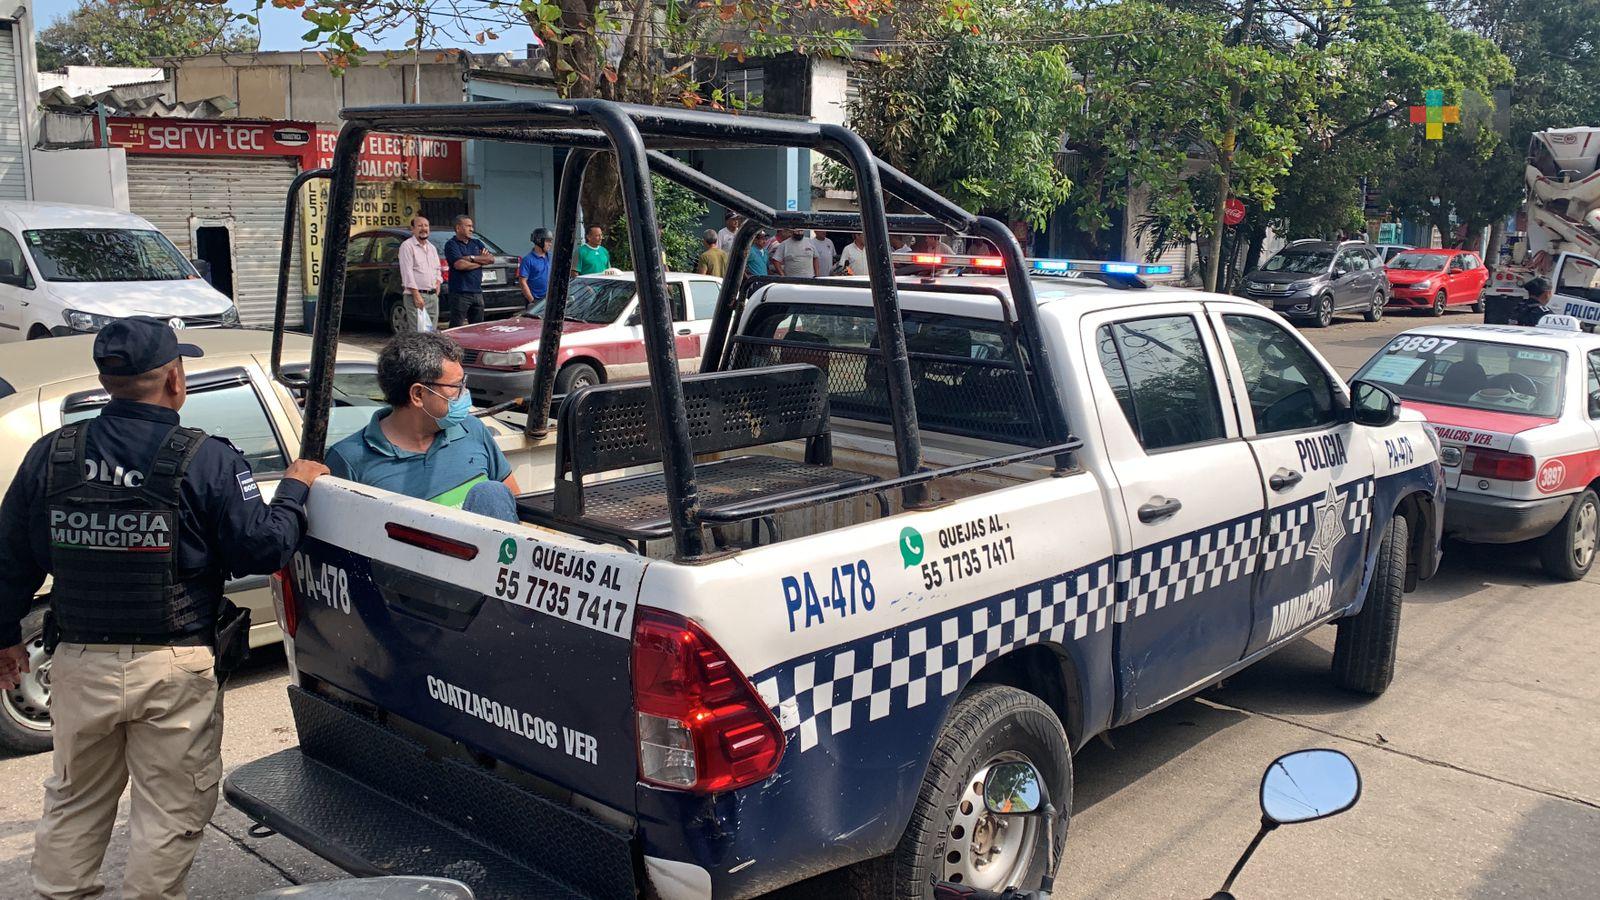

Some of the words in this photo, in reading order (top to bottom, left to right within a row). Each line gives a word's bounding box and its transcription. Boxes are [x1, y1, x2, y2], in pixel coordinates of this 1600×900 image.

[382, 202, 398, 214] DE
[1544, 315, 1570, 326] TAXI
[1389, 335, 1459, 355] 3897
[1294, 432, 1348, 473] POLICIA
[1384, 435, 1414, 470] PA-478
[1540, 465, 1564, 487] 3897
[50, 505, 170, 533] POLICÍA
[938, 517, 986, 549] QUEJAS
[50, 527, 171, 548] MUNICIPAL
[531, 545, 596, 584] QUEJAS
[600, 565, 622, 591] AL
[921, 560, 943, 591] 55
[943, 546, 982, 582] 7735
[982, 535, 1016, 569] 7417
[293, 550, 351, 615] PA-478
[494, 566, 520, 600] 55
[526, 575, 570, 617] 7735
[576, 588, 628, 633] 7417
[781, 559, 876, 633] PA-478
[426, 674, 559, 750] COATZACOALCOS
[562, 726, 599, 766] VER
